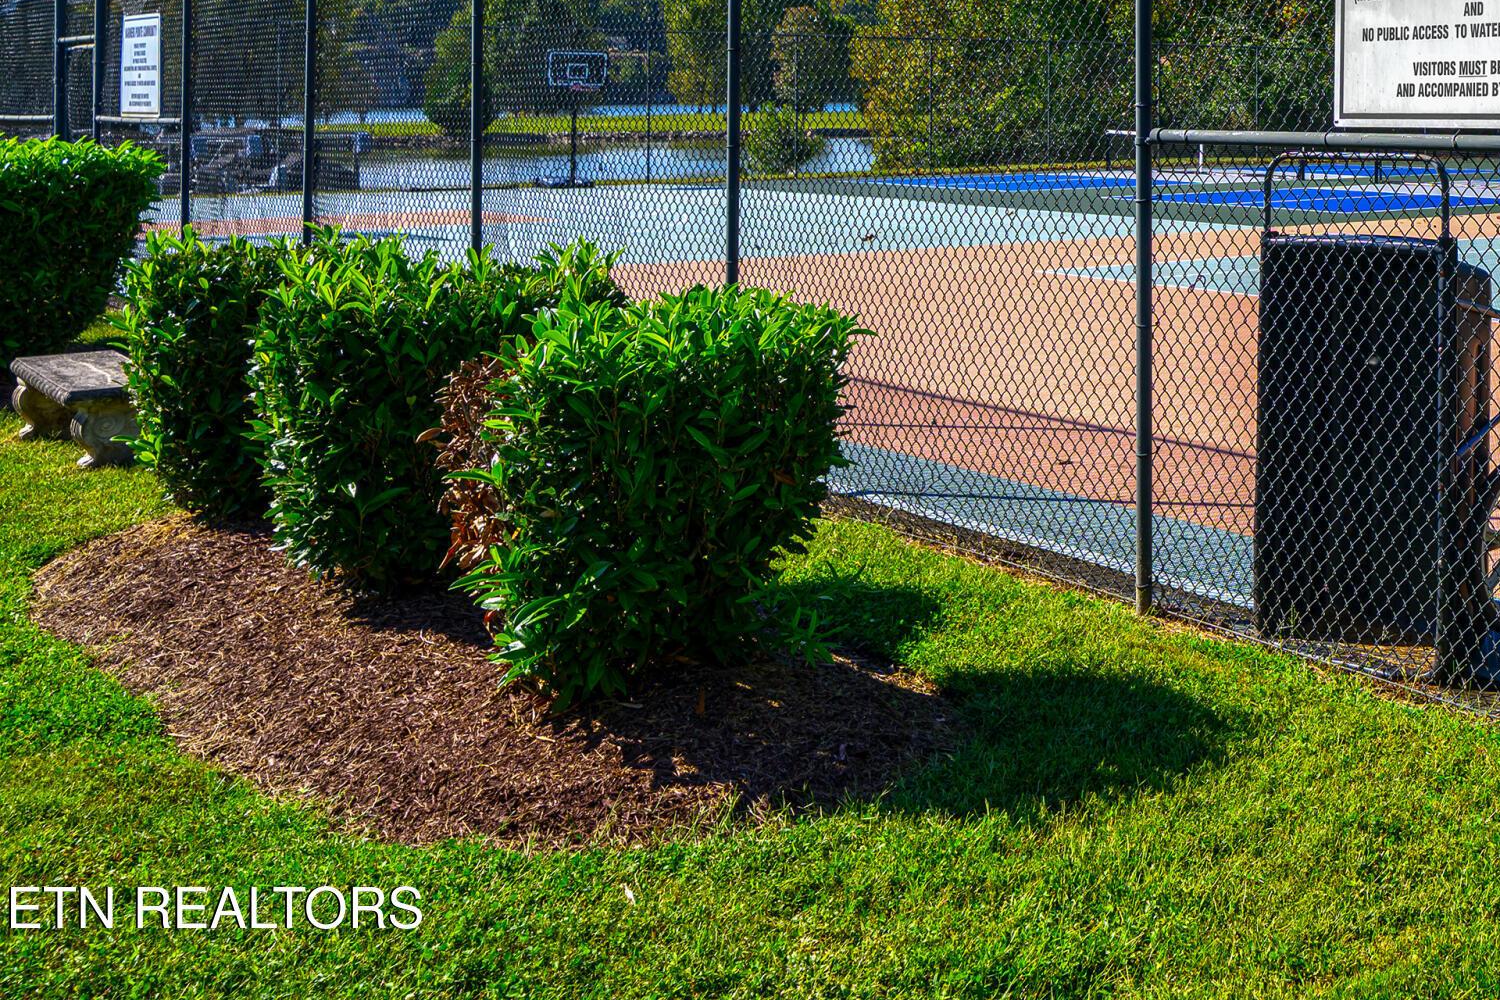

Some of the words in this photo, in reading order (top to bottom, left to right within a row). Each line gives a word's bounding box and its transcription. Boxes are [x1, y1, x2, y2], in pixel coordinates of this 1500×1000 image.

[1463, 1, 1484, 17] AND
[1361, 27, 1375, 42] NO
[1376, 25, 1410, 42] PUBLIC
[1411, 24, 1449, 41] ACCESS
[1454, 23, 1468, 39] TO
[1412, 60, 1457, 77] VISITORS
[1458, 60, 1488, 78] MUST
[1396, 82, 1416, 98] AND
[1417, 82, 1489, 98] ACCOMPANIED
